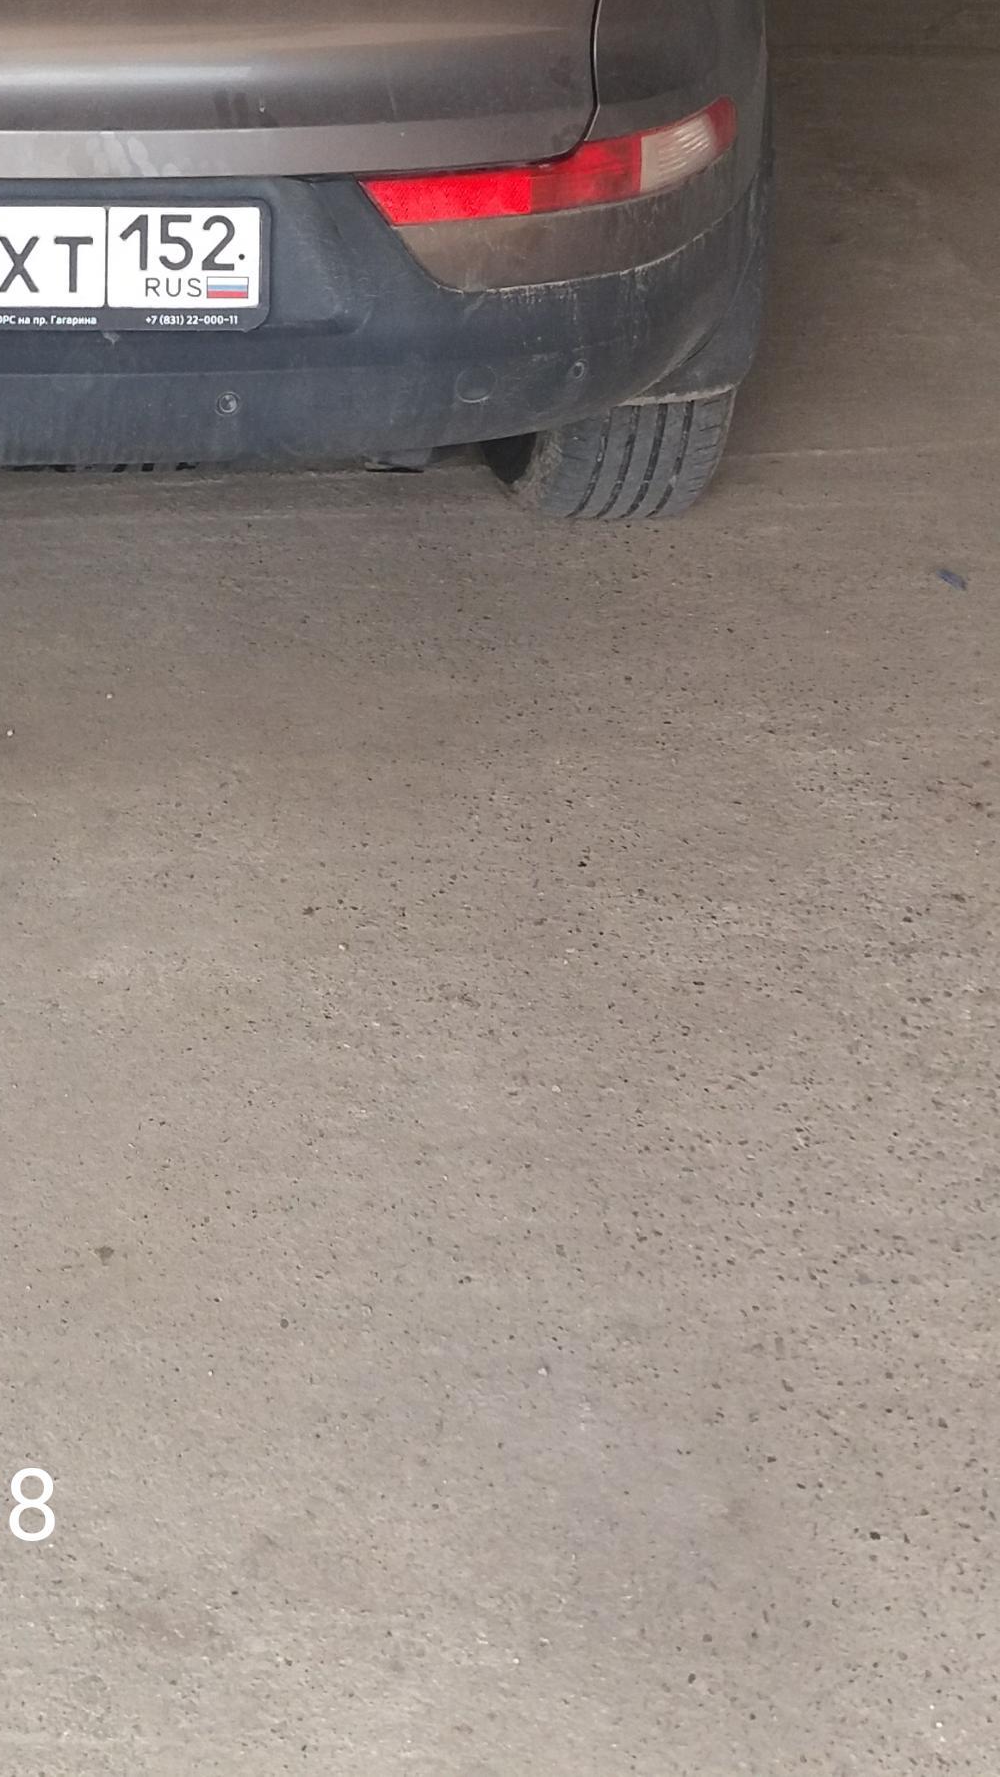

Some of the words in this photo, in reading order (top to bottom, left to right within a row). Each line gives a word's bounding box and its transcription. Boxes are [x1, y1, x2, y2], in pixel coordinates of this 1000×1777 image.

[119, 213, 236, 273] 152
[144, 277, 202, 299] RUS
[18, 316, 31, 325] на
[33, 317, 48, 328] пр.
[50, 314, 97, 328] Гагарина
[146, 314, 158, 325] +7
[159, 314, 185, 327] (831)
[186, 314, 239, 326] 22-000-11
